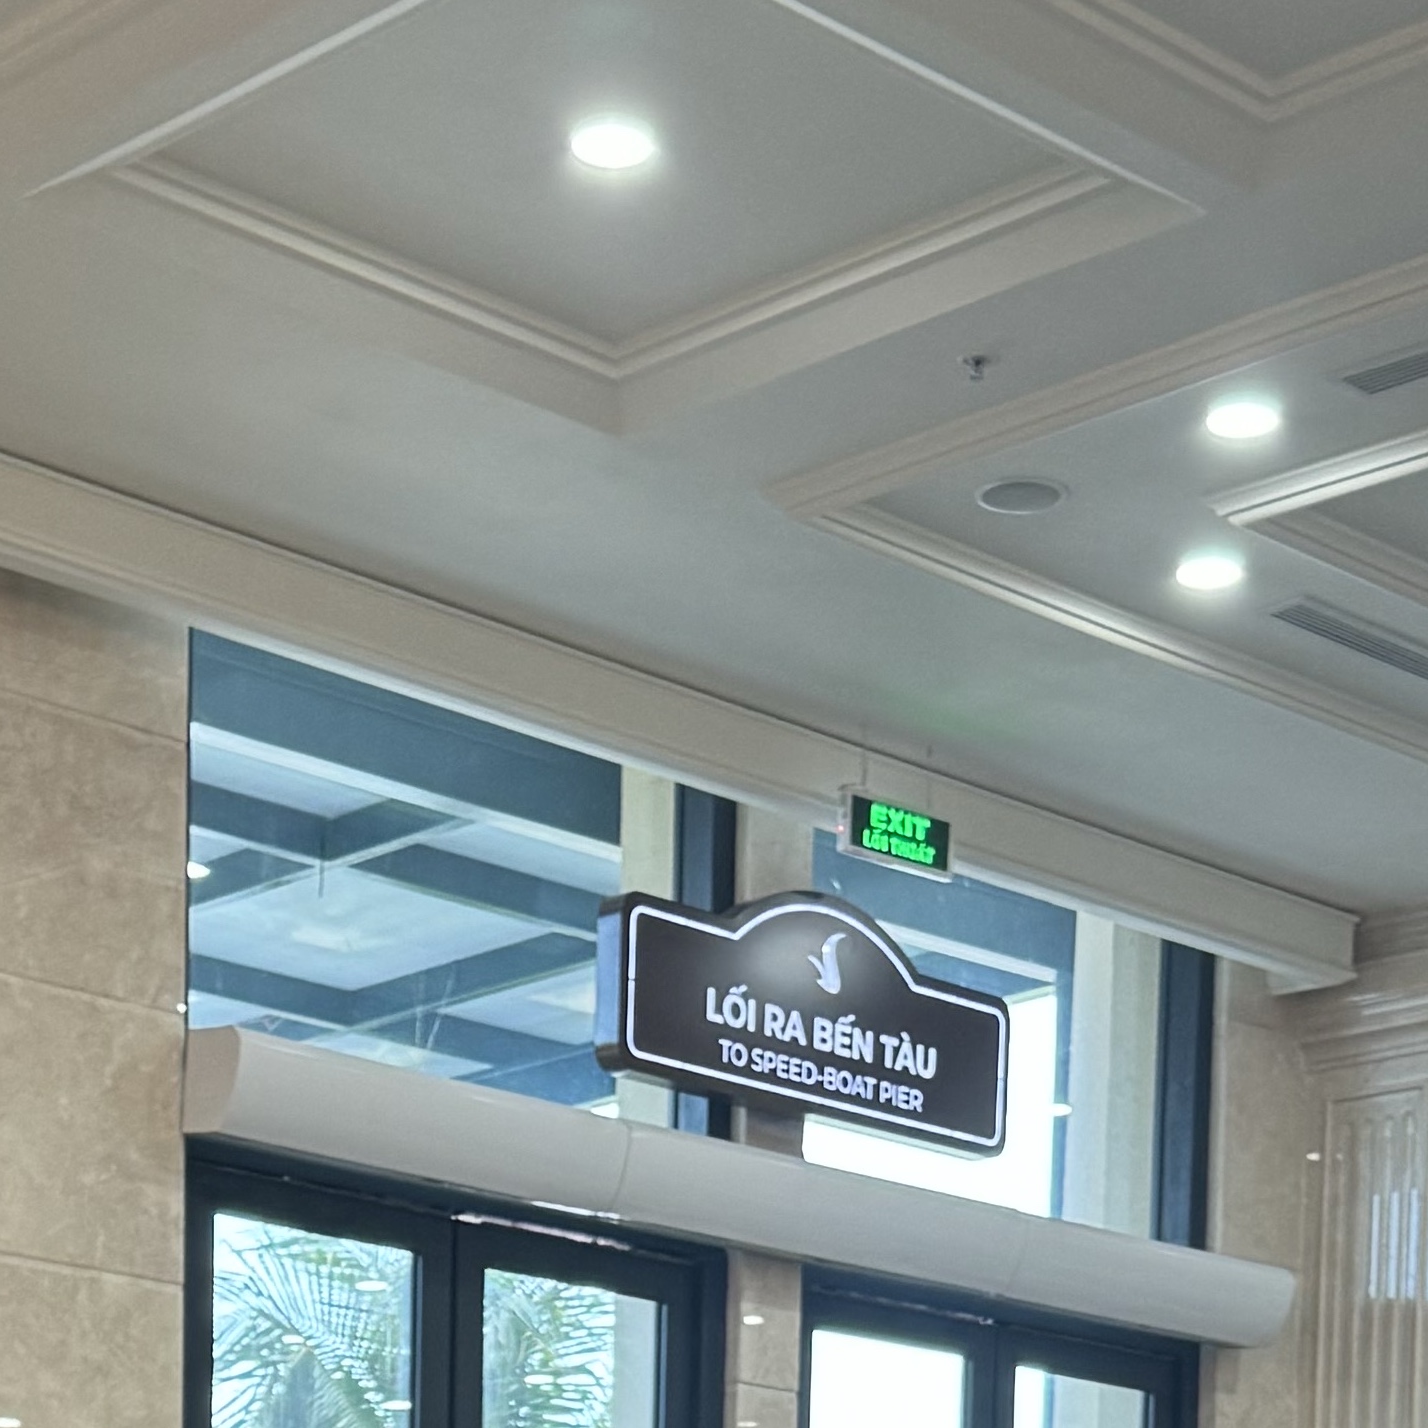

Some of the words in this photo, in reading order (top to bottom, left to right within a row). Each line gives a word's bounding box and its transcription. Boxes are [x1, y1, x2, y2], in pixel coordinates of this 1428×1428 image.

[870, 803, 931, 840] EXIT
[706, 985, 756, 1032] LỐI
[764, 1003, 807, 1046] RA
[813, 1014, 873, 1063] BẾN
[879, 1031, 937, 1079] TÀU
[718, 1038, 748, 1067] TO
[750, 1047, 877, 1100] SPEED-BOAT
[879, 1081, 924, 1112] PIER
